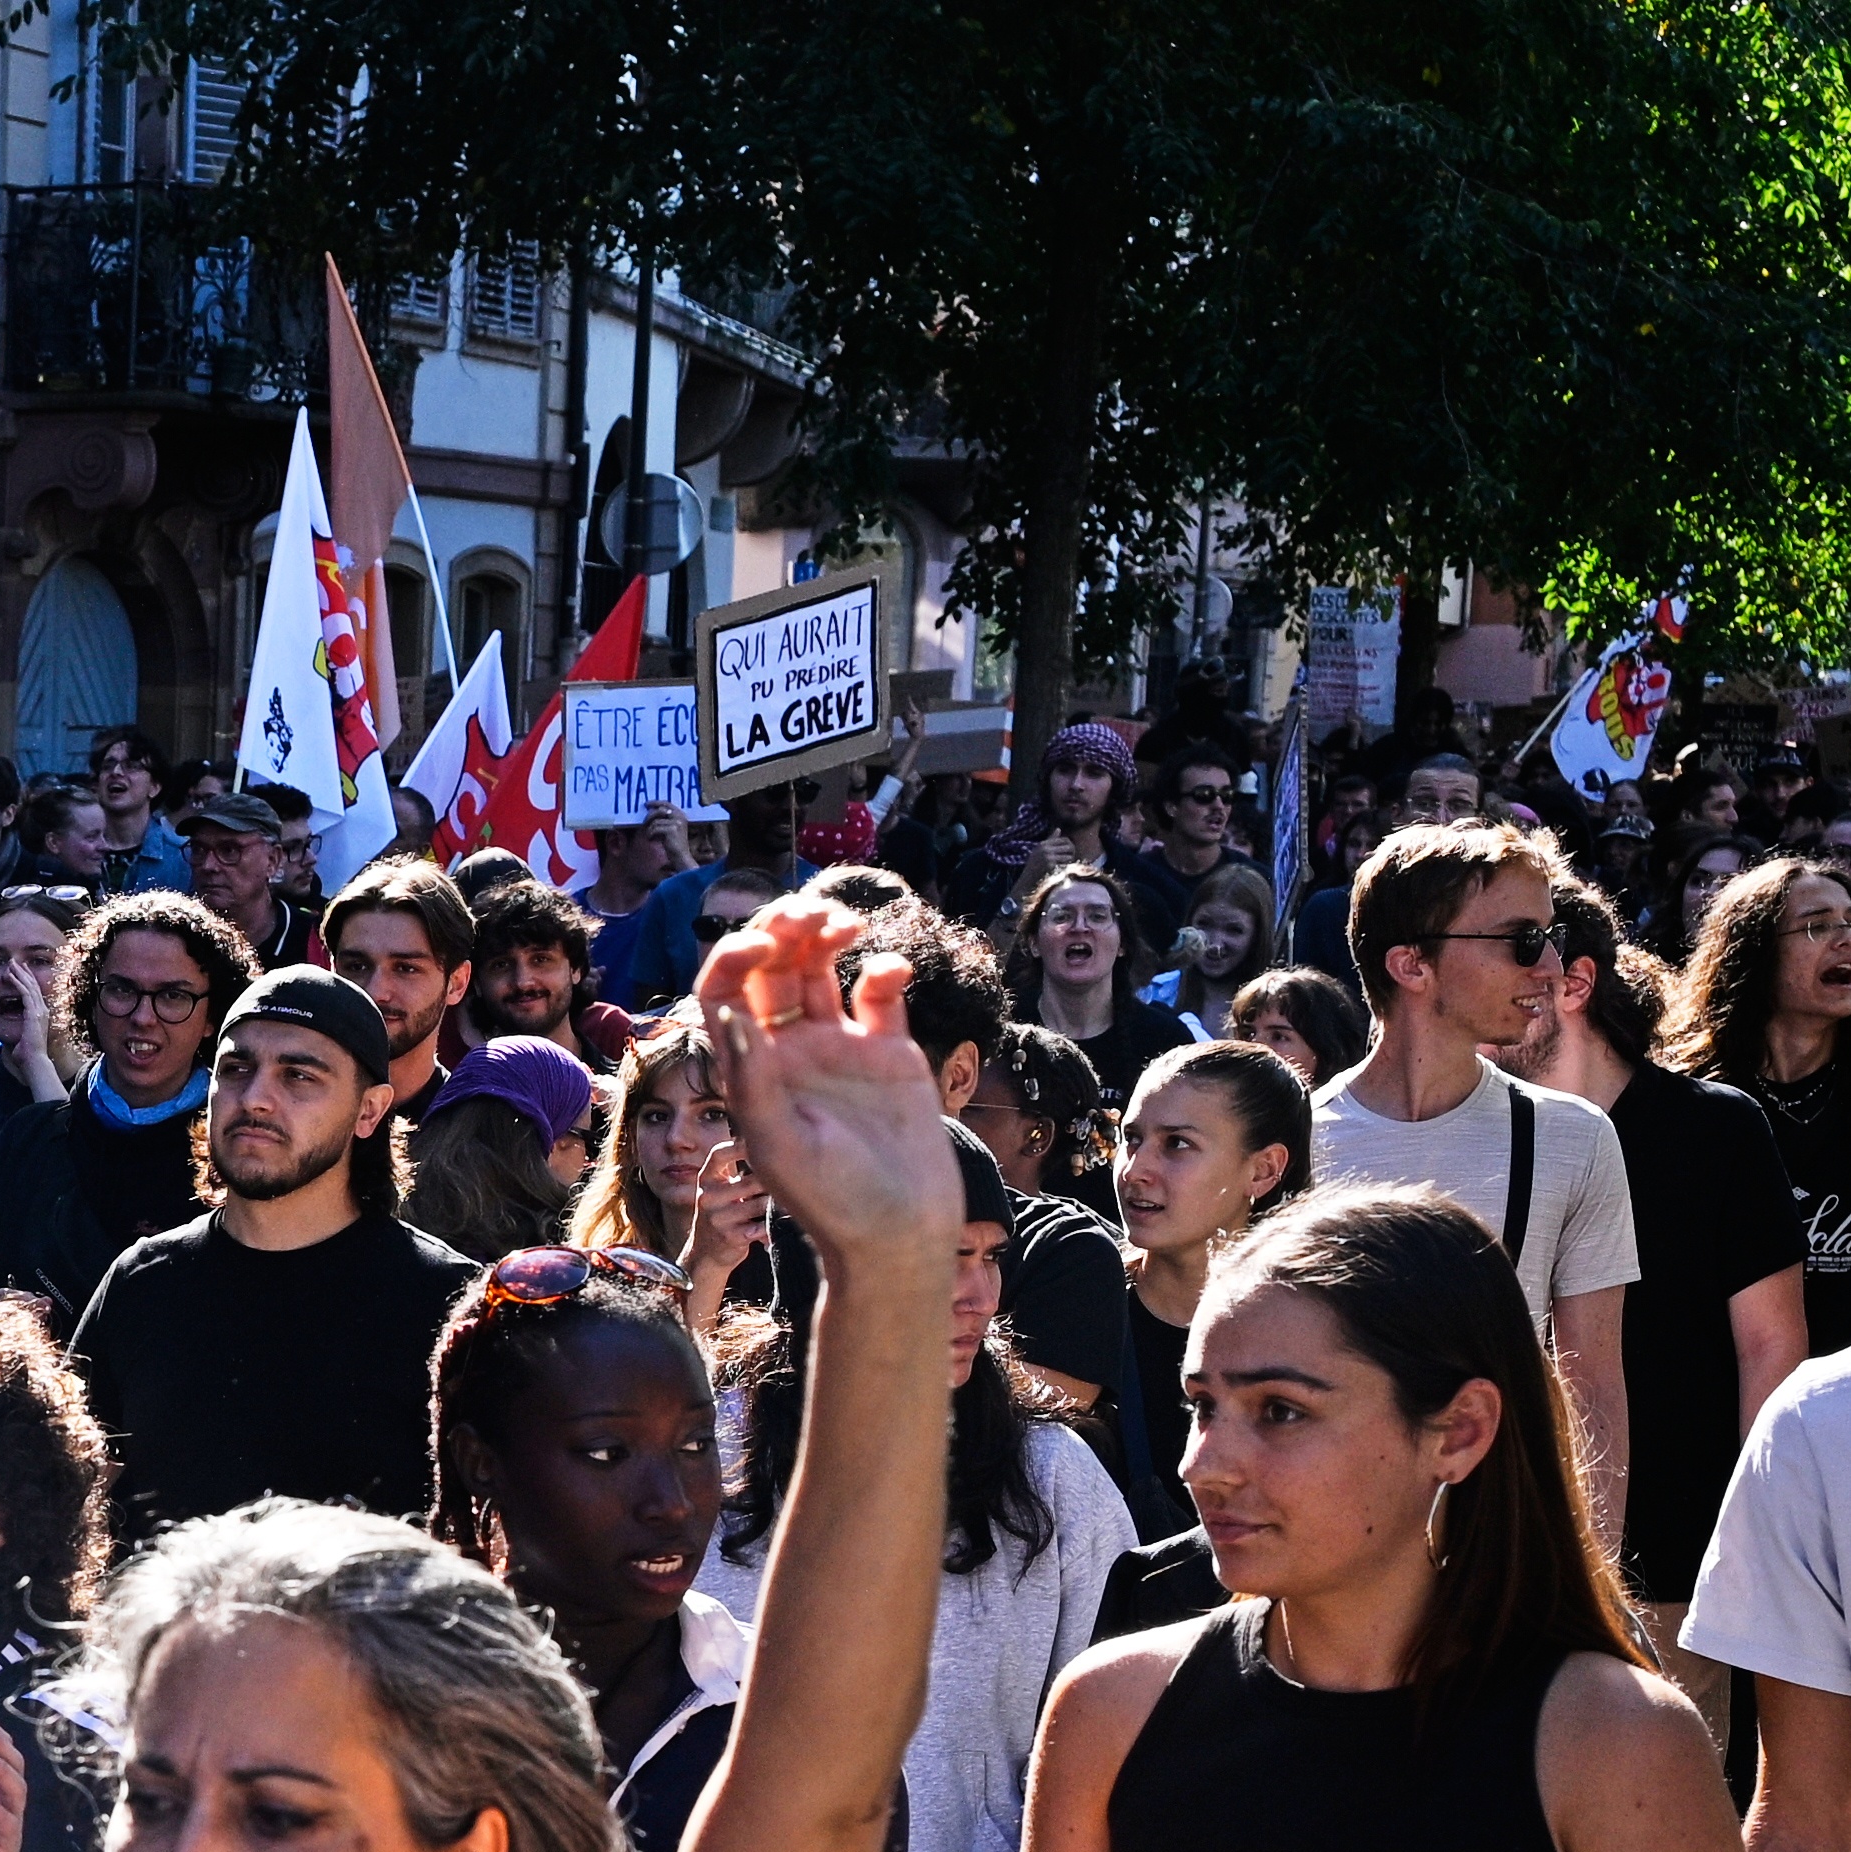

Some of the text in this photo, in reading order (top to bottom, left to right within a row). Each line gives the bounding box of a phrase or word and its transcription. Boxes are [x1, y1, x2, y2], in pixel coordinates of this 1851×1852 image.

[719, 600, 870, 680] QUI AURAIT
[750, 653, 861, 702] PU PRÉDIRE
[574, 700, 648, 749] ÊTRE
[726, 683, 865, 759] LA GRÈVE
[574, 763, 610, 794] PAS
